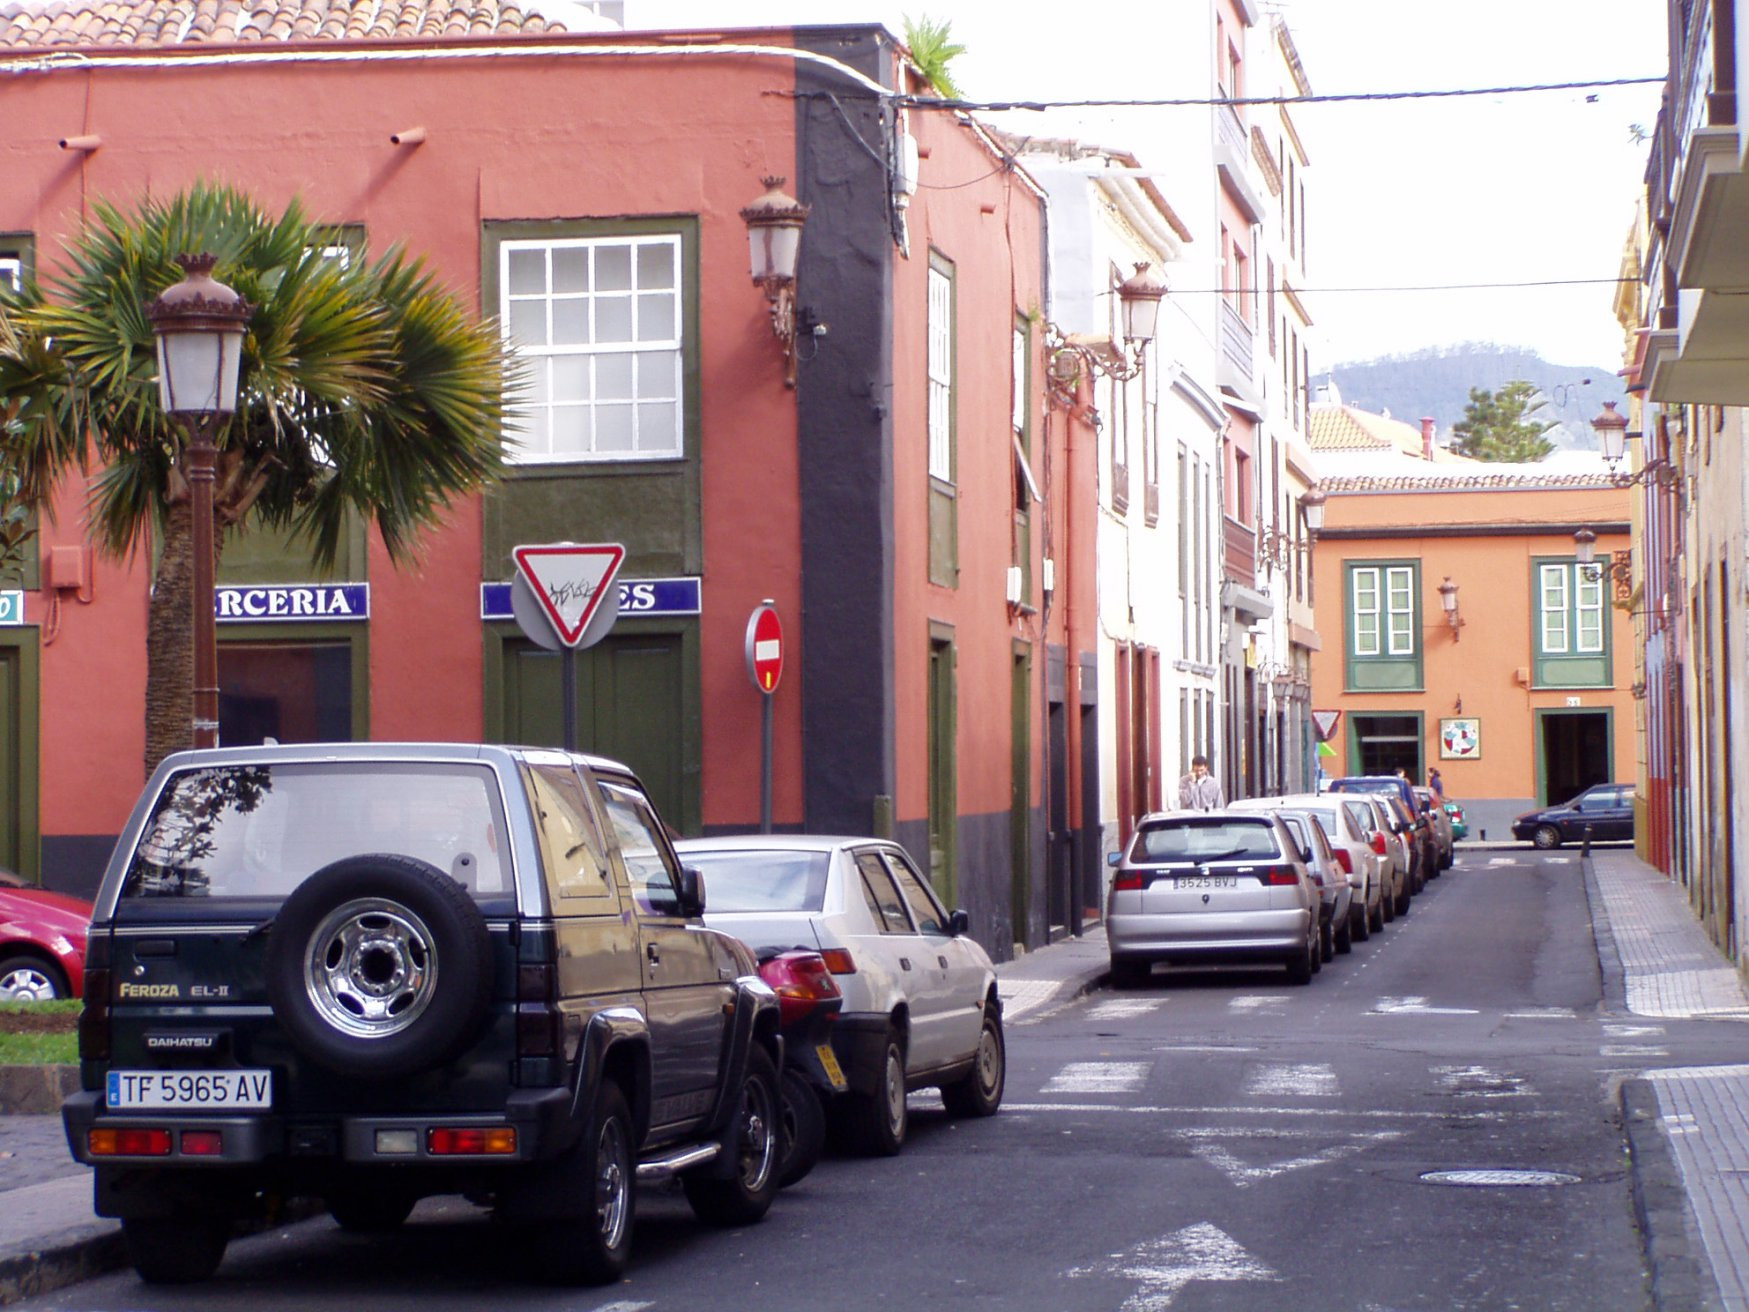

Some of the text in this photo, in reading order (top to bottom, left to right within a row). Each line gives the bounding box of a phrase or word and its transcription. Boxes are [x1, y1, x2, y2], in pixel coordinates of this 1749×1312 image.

[215, 589, 352, 616] RCERIA
[619, 584, 655, 610] ES
[119, 982, 180, 997] FEROZA
[148, 1038, 213, 1047] DAIHATSU
[123, 1074, 267, 1102] TF 5965 AV
